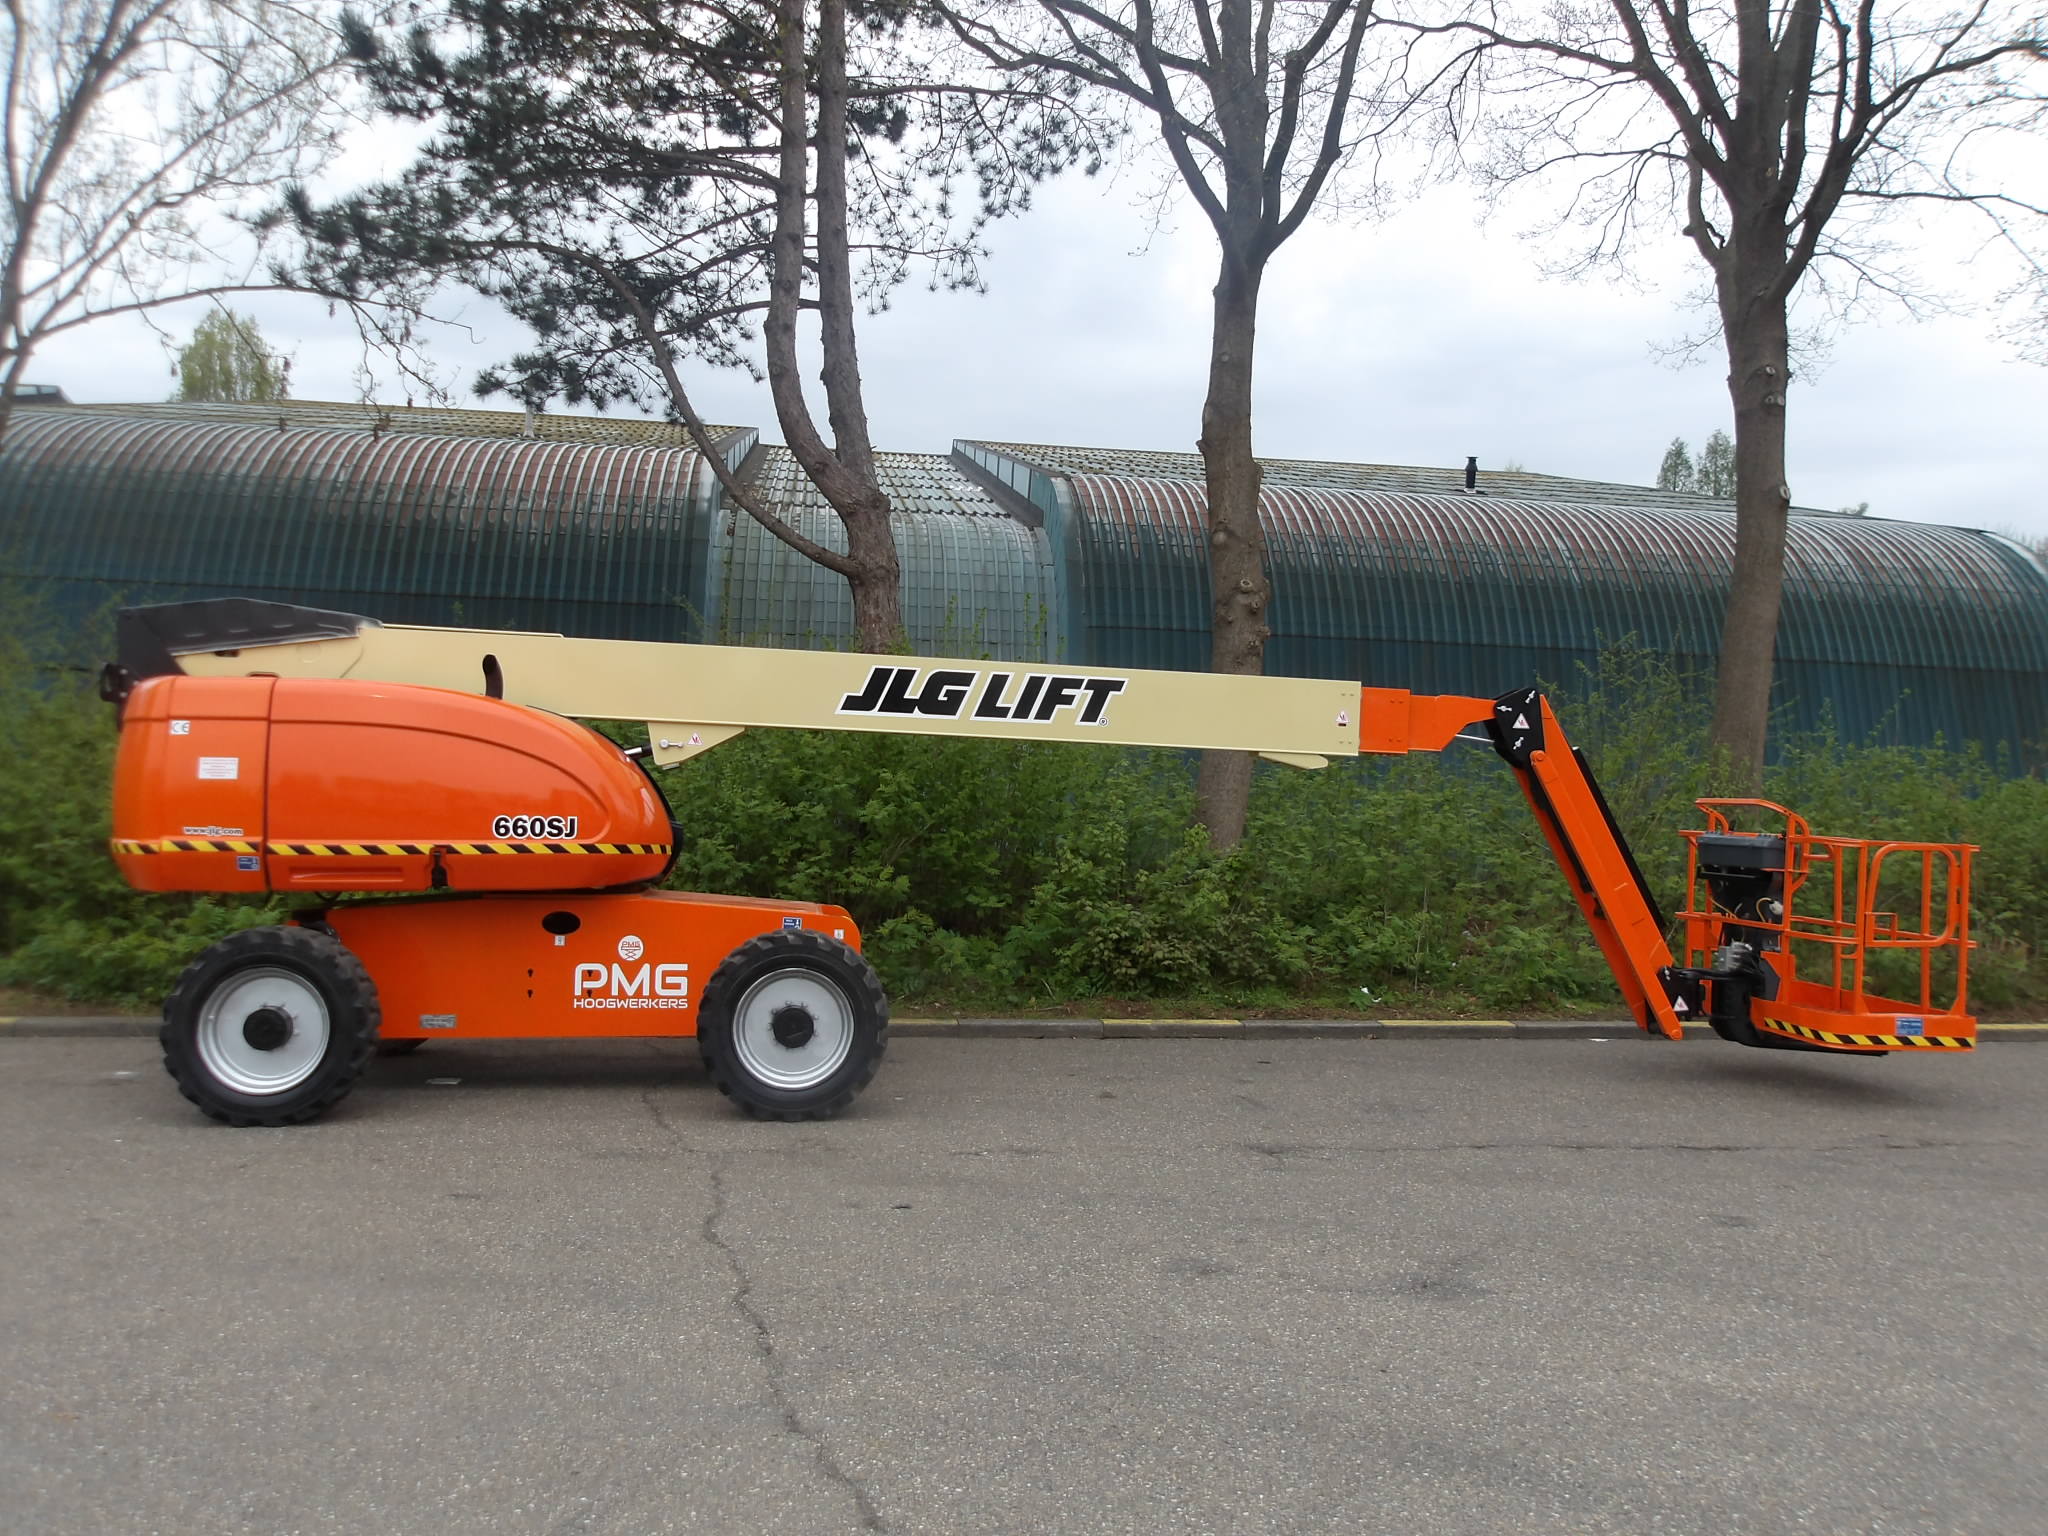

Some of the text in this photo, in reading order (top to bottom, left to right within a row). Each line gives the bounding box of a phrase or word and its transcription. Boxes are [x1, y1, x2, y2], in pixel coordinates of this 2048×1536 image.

[836, 665, 978, 718] JLG
[184, 827, 243, 836] www.jlg.com
[493, 815, 578, 839] 660SJ
[574, 963, 688, 997] PMG
[573, 998, 688, 1009] HOOGWERKERS
